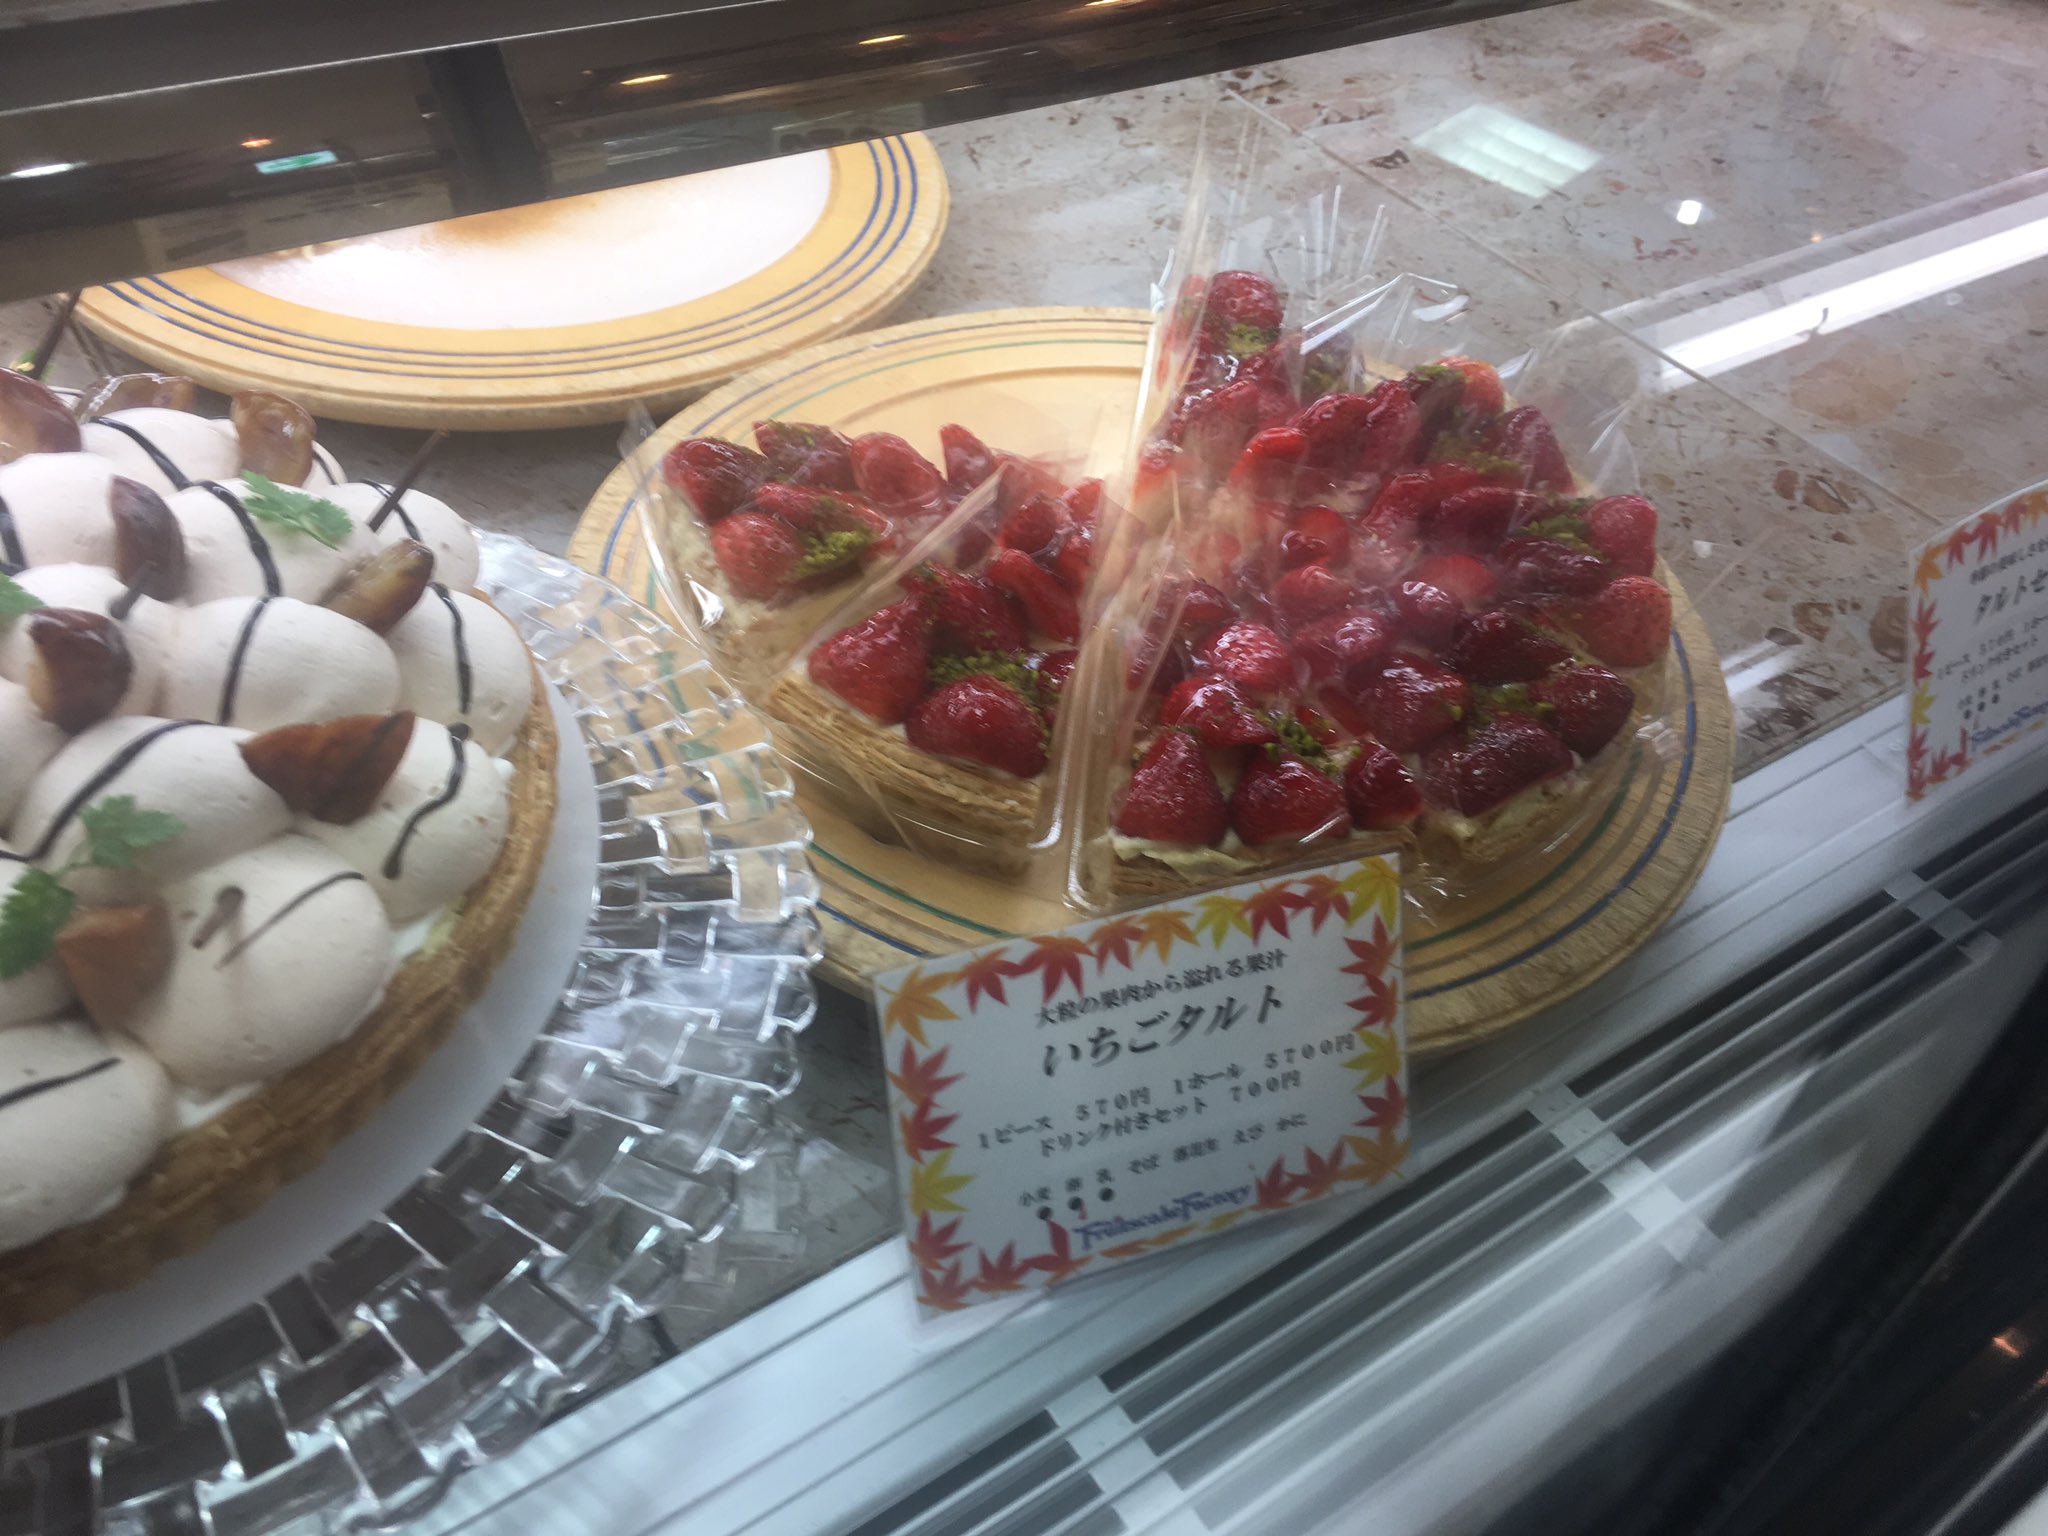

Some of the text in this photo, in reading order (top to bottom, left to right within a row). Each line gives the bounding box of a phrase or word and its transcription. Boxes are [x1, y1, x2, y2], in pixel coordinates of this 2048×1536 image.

[1042, 984, 1283, 1078] いちごタルト
[1075, 1085, 1151, 1122] 570円
[1265, 1032, 1356, 1070] 5700円
[1231, 1069, 1301, 1103] 700円
